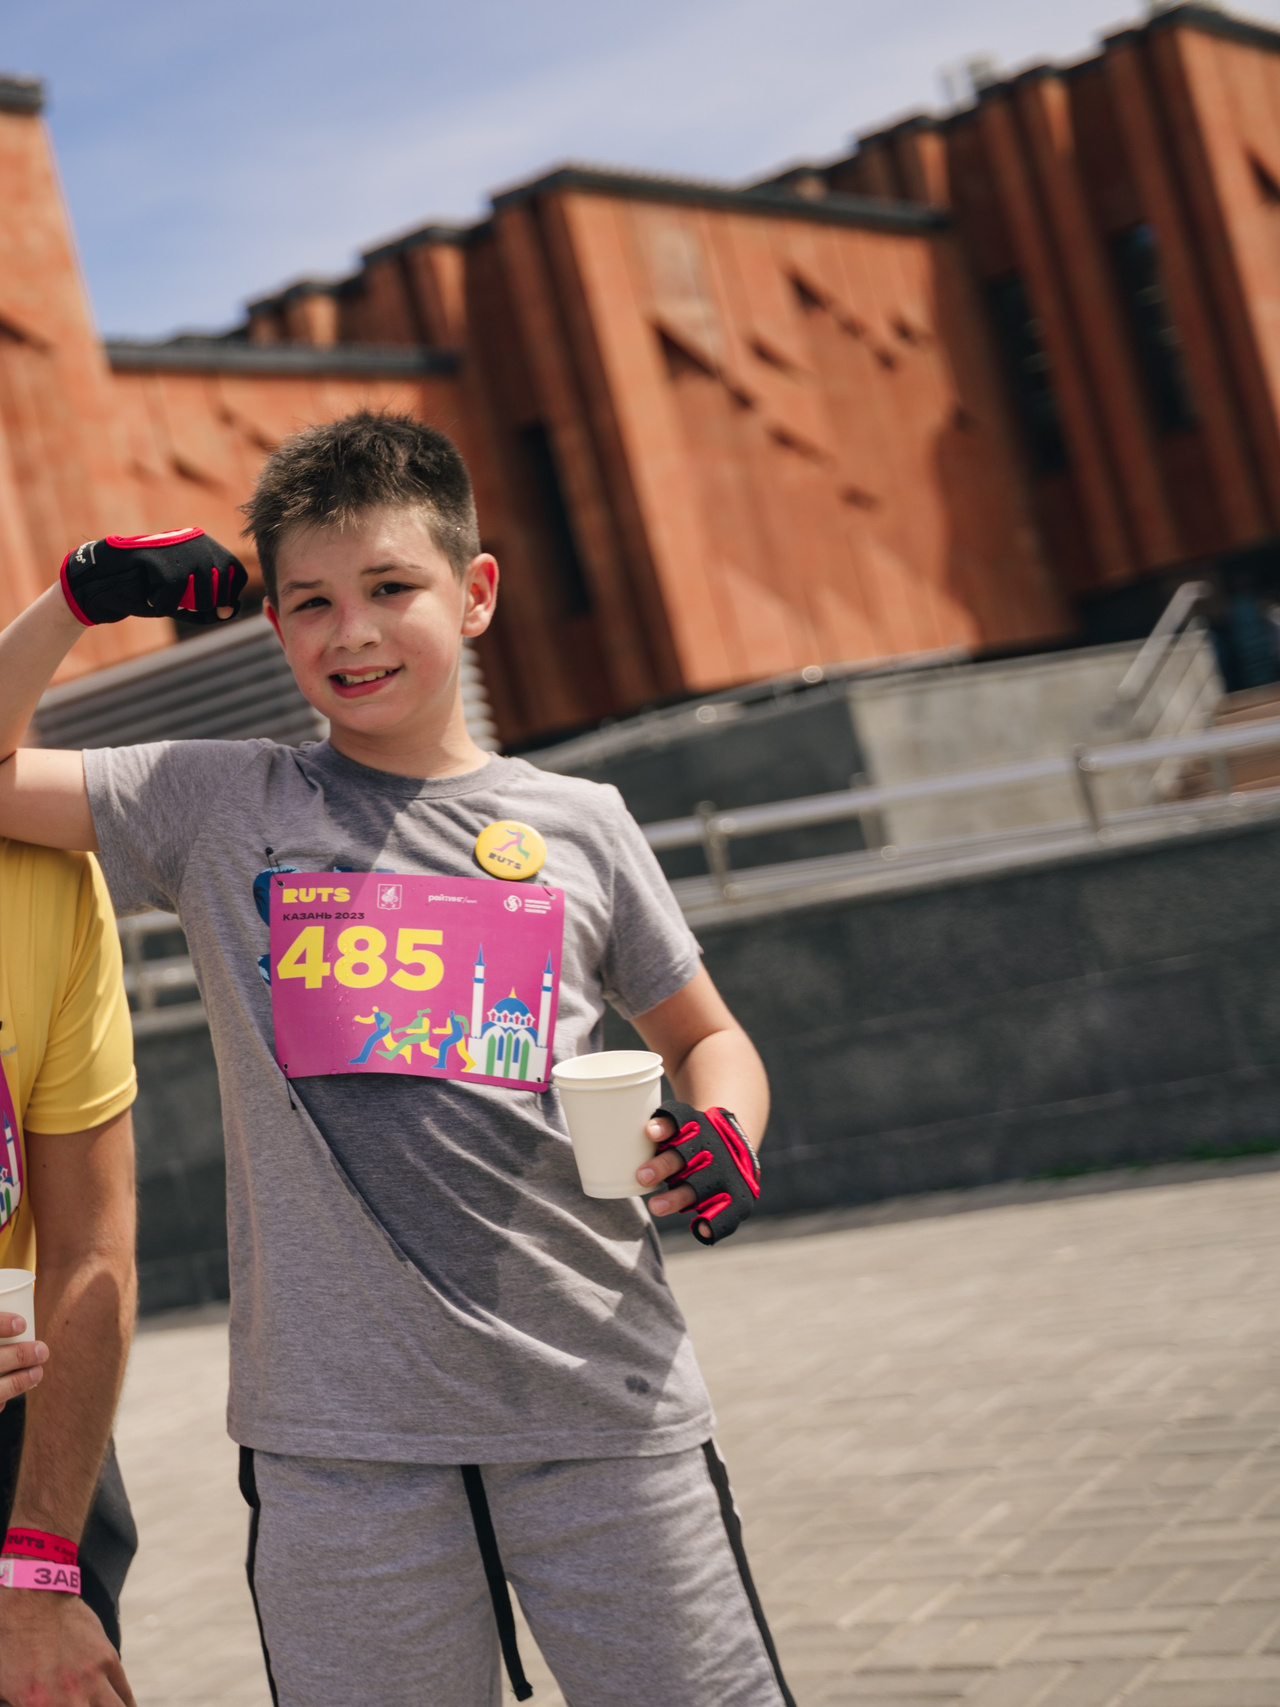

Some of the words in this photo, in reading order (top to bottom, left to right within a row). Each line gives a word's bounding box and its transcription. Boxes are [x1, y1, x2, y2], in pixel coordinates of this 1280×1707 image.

[488, 852, 523, 870] RUTS
[282, 887, 351, 904] RUTS
[282, 912, 332, 921] КАЗАНЬ
[335, 911, 366, 920] 2023
[276, 925, 445, 991] 485
